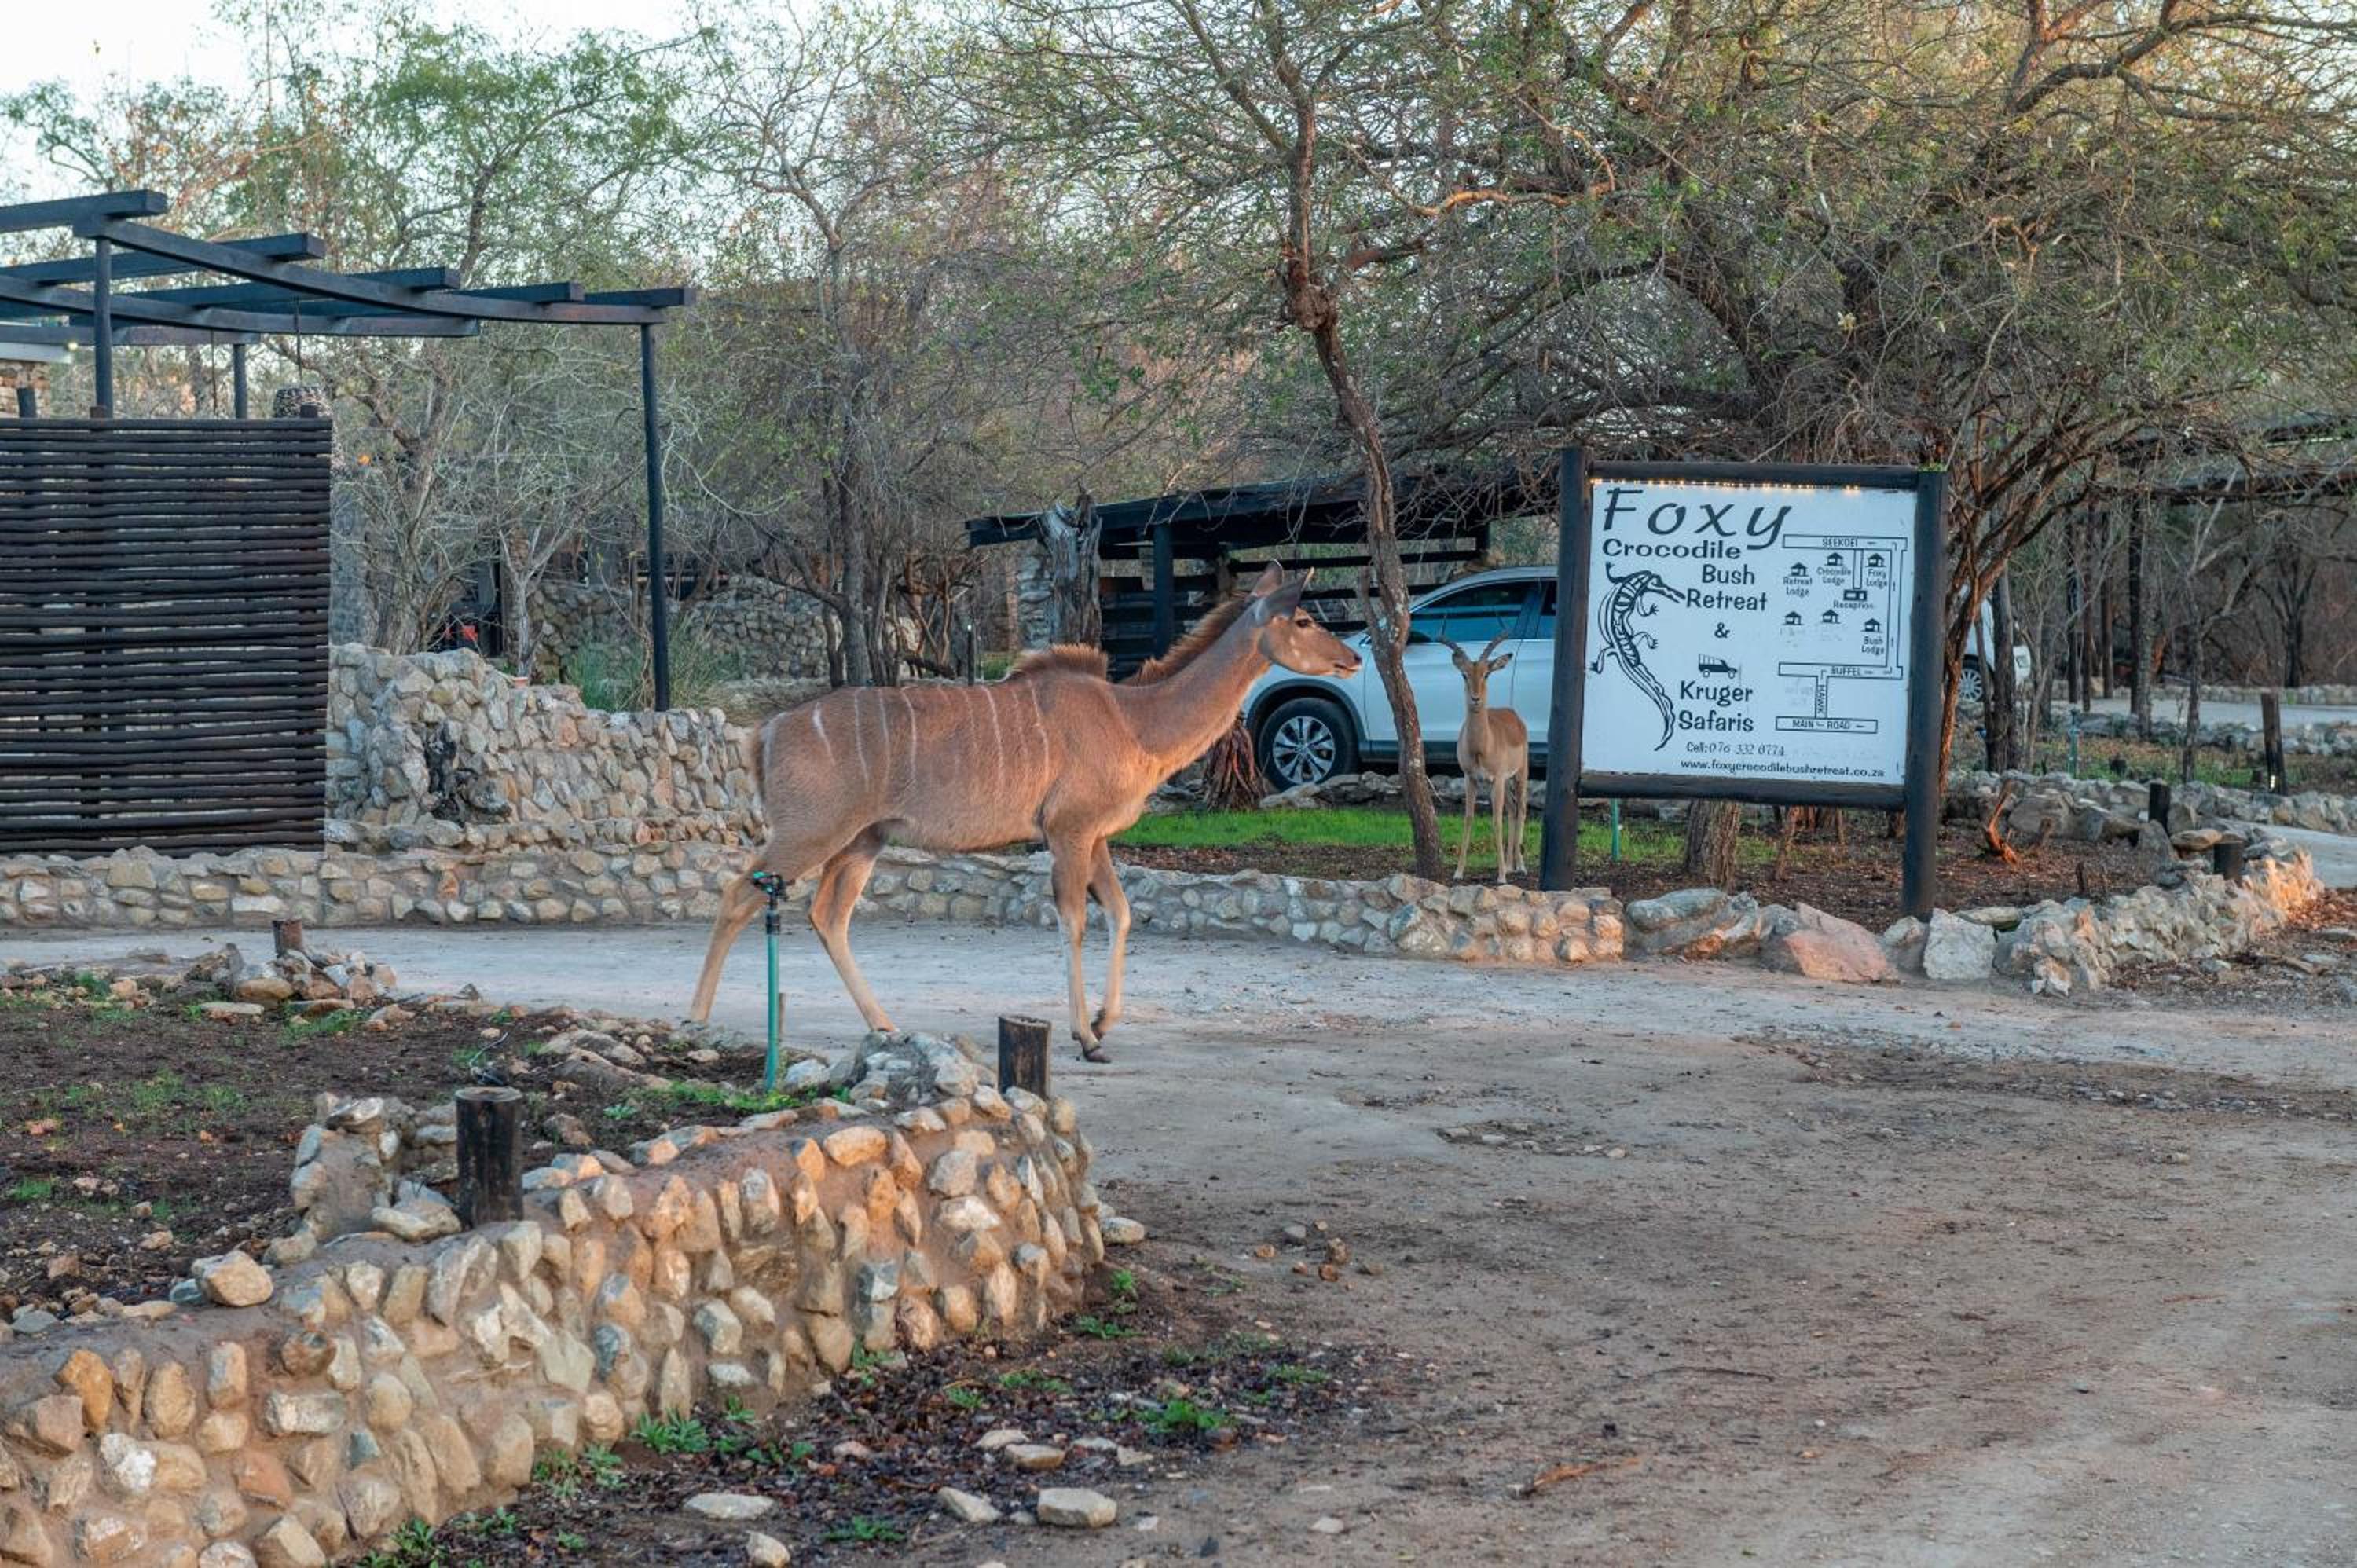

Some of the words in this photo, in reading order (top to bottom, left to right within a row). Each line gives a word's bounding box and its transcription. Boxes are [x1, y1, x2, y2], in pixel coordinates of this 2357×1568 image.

[1603, 487, 1792, 550] Foxy
[1602, 538, 1742, 559] Crocodile
[1702, 563, 1755, 585] Bush
[1868, 569, 1886, 579] Foxy
[1783, 577, 1813, 585] Retreat
[1822, 577, 1845, 586] Lodge
[1866, 578, 1887, 589] Lodge
[1786, 587, 1809, 598] Lodge
[1686, 588, 1768, 611] Retreat
[1714, 622, 1730, 638] &
[1864, 636, 1883, 645] Bush
[1861, 646, 1885, 656] Lodge
[1831, 667, 1861, 676] BUFFEL
[1680, 680, 1754, 707] Kruger
[1678, 709, 1754, 732] Safaris
[1792, 720, 1814, 728] MAIN
[1827, 720, 1851, 730] ROAD
[1681, 759, 1885, 777] www.foxycrocodilebushretreat.co.za
